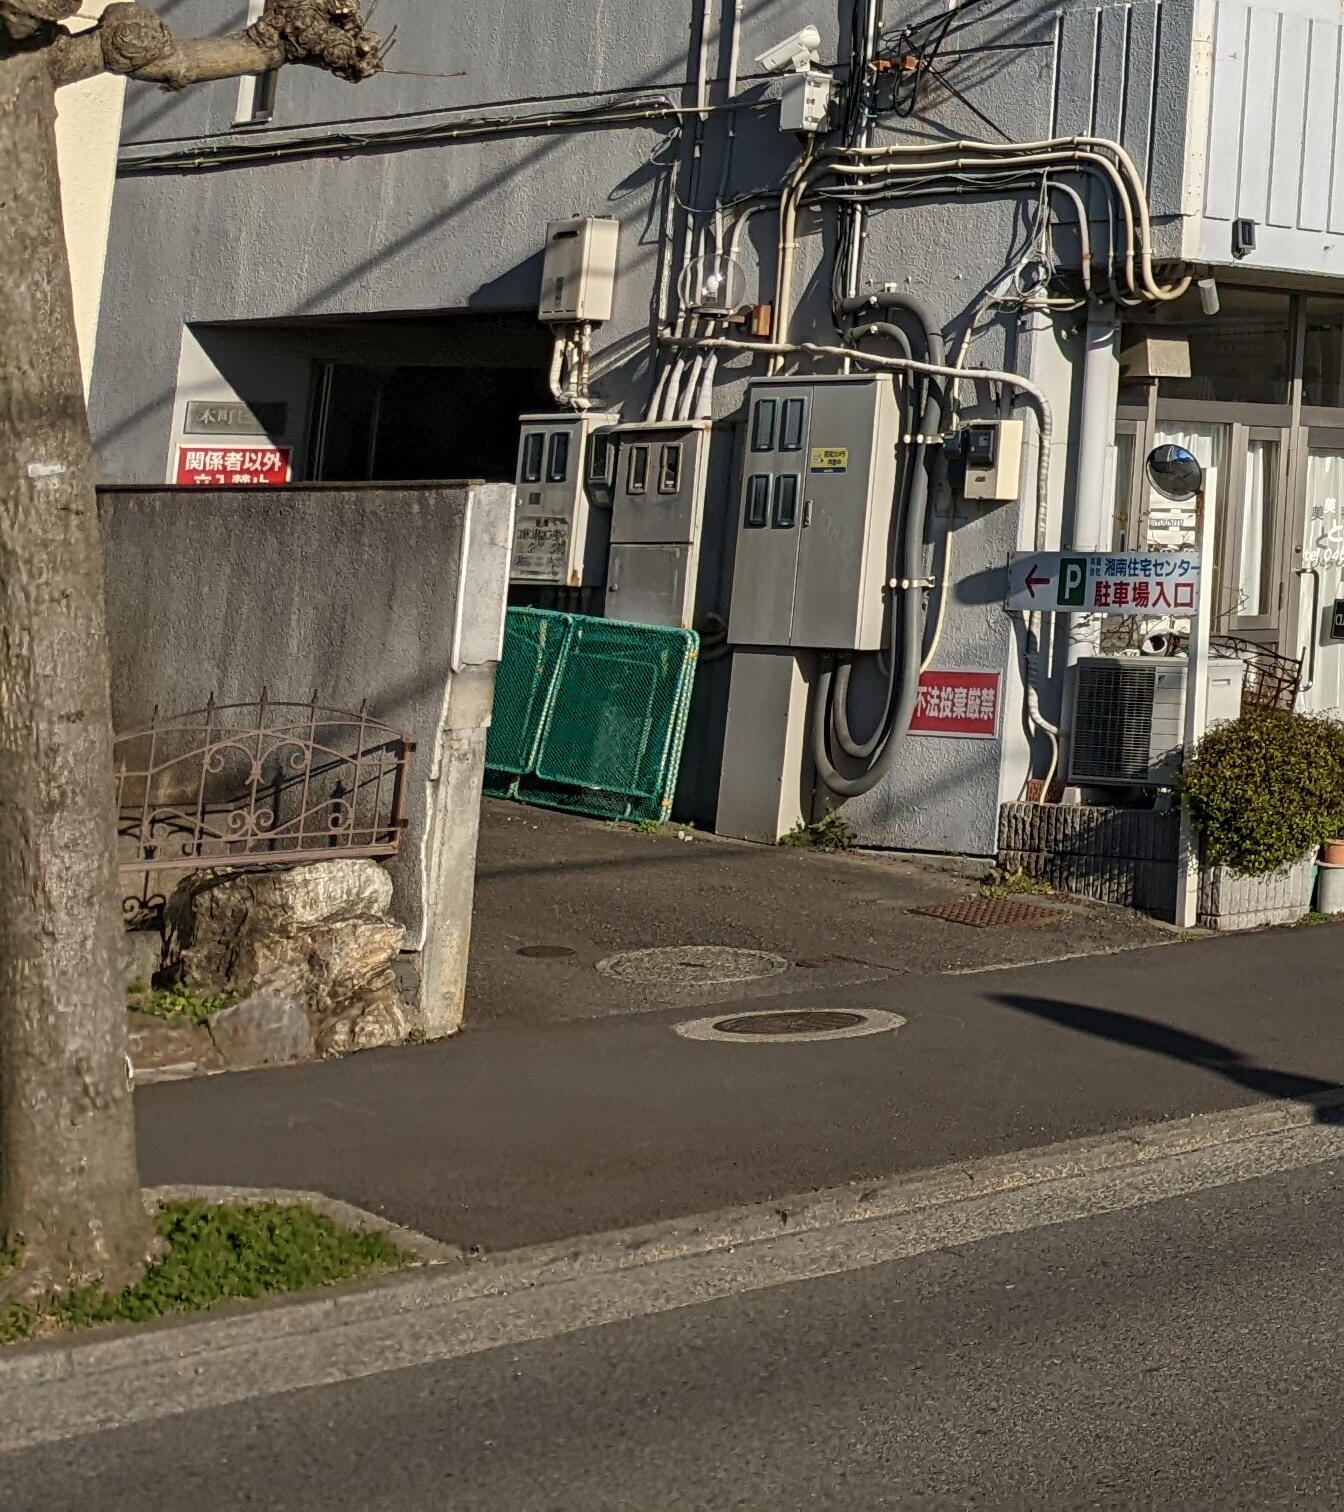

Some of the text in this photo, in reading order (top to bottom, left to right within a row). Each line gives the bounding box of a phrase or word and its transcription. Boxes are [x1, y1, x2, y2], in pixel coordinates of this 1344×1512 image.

[185, 450, 282, 472] 関係者以外
[1104, 557, 1200, 578] 湘南住宅センター
[1094, 580, 1195, 608] 駐車場入口
